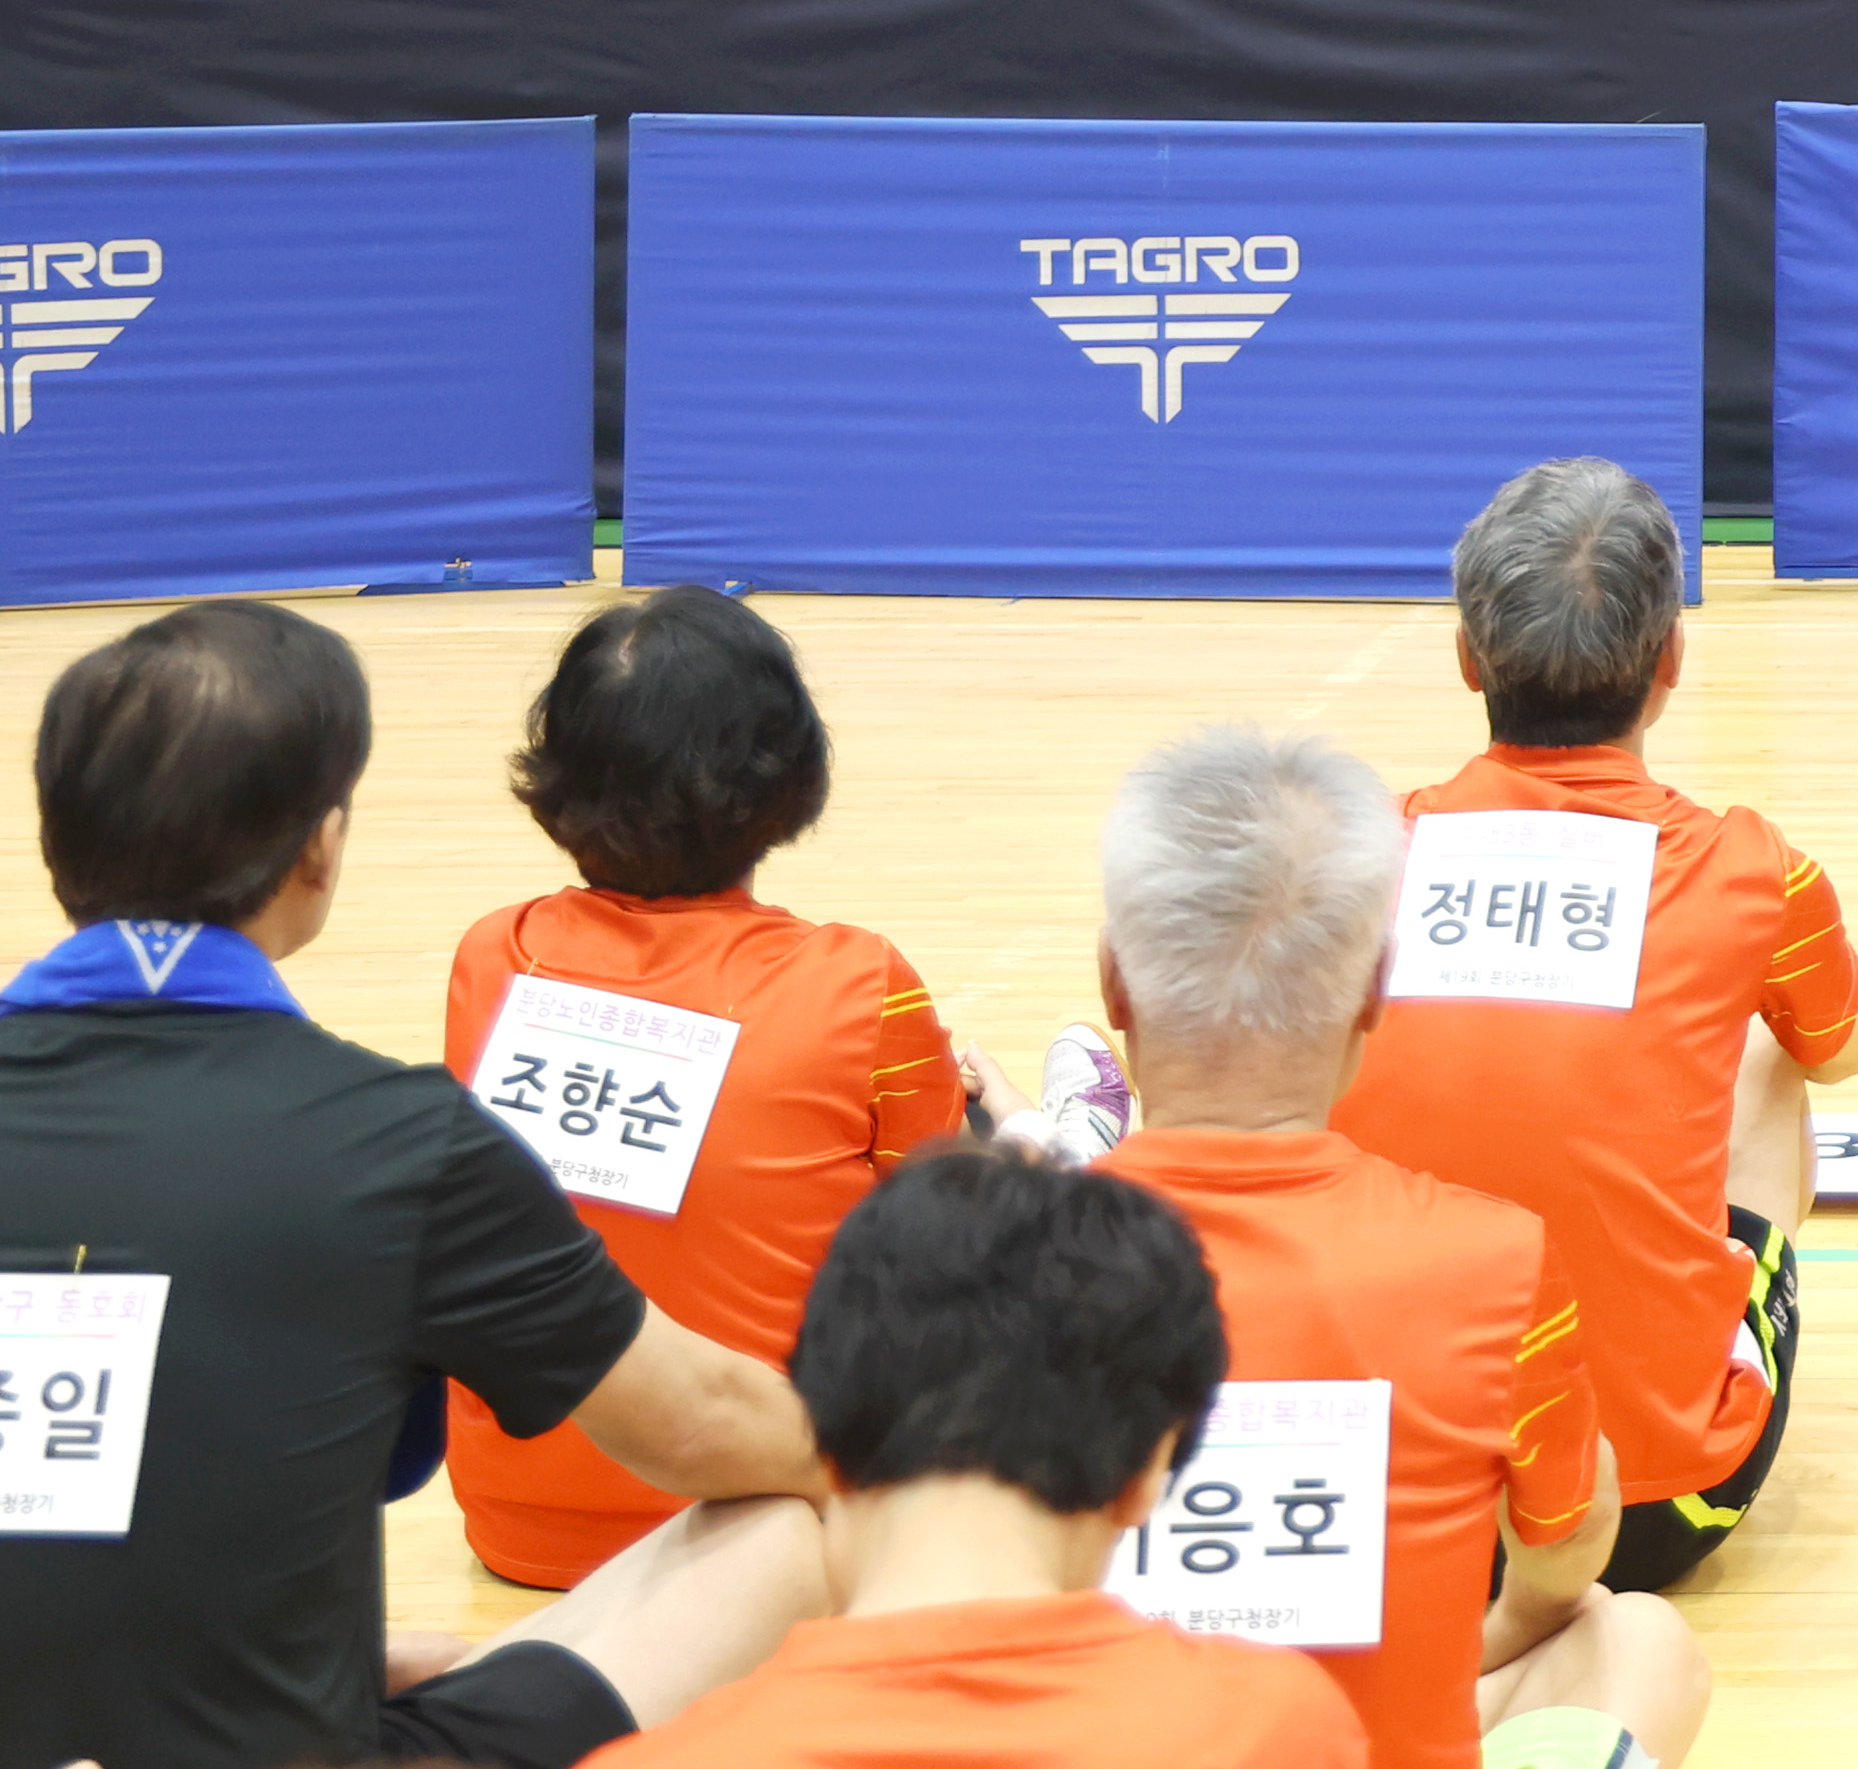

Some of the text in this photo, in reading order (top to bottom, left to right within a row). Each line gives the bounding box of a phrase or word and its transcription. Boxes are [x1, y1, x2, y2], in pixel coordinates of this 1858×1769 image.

[1019, 234, 1300, 286] TAGRO
[1420, 878, 1618, 953] 정태형
[516, 988, 723, 1056] 분당노인종합복지관
[489, 1052, 683, 1154] 조향순
[55, 1290, 147, 1324] 동호회
[1136, 1477, 1350, 1576] 응호
[1186, 1605, 1301, 1631] 분당구청장기
